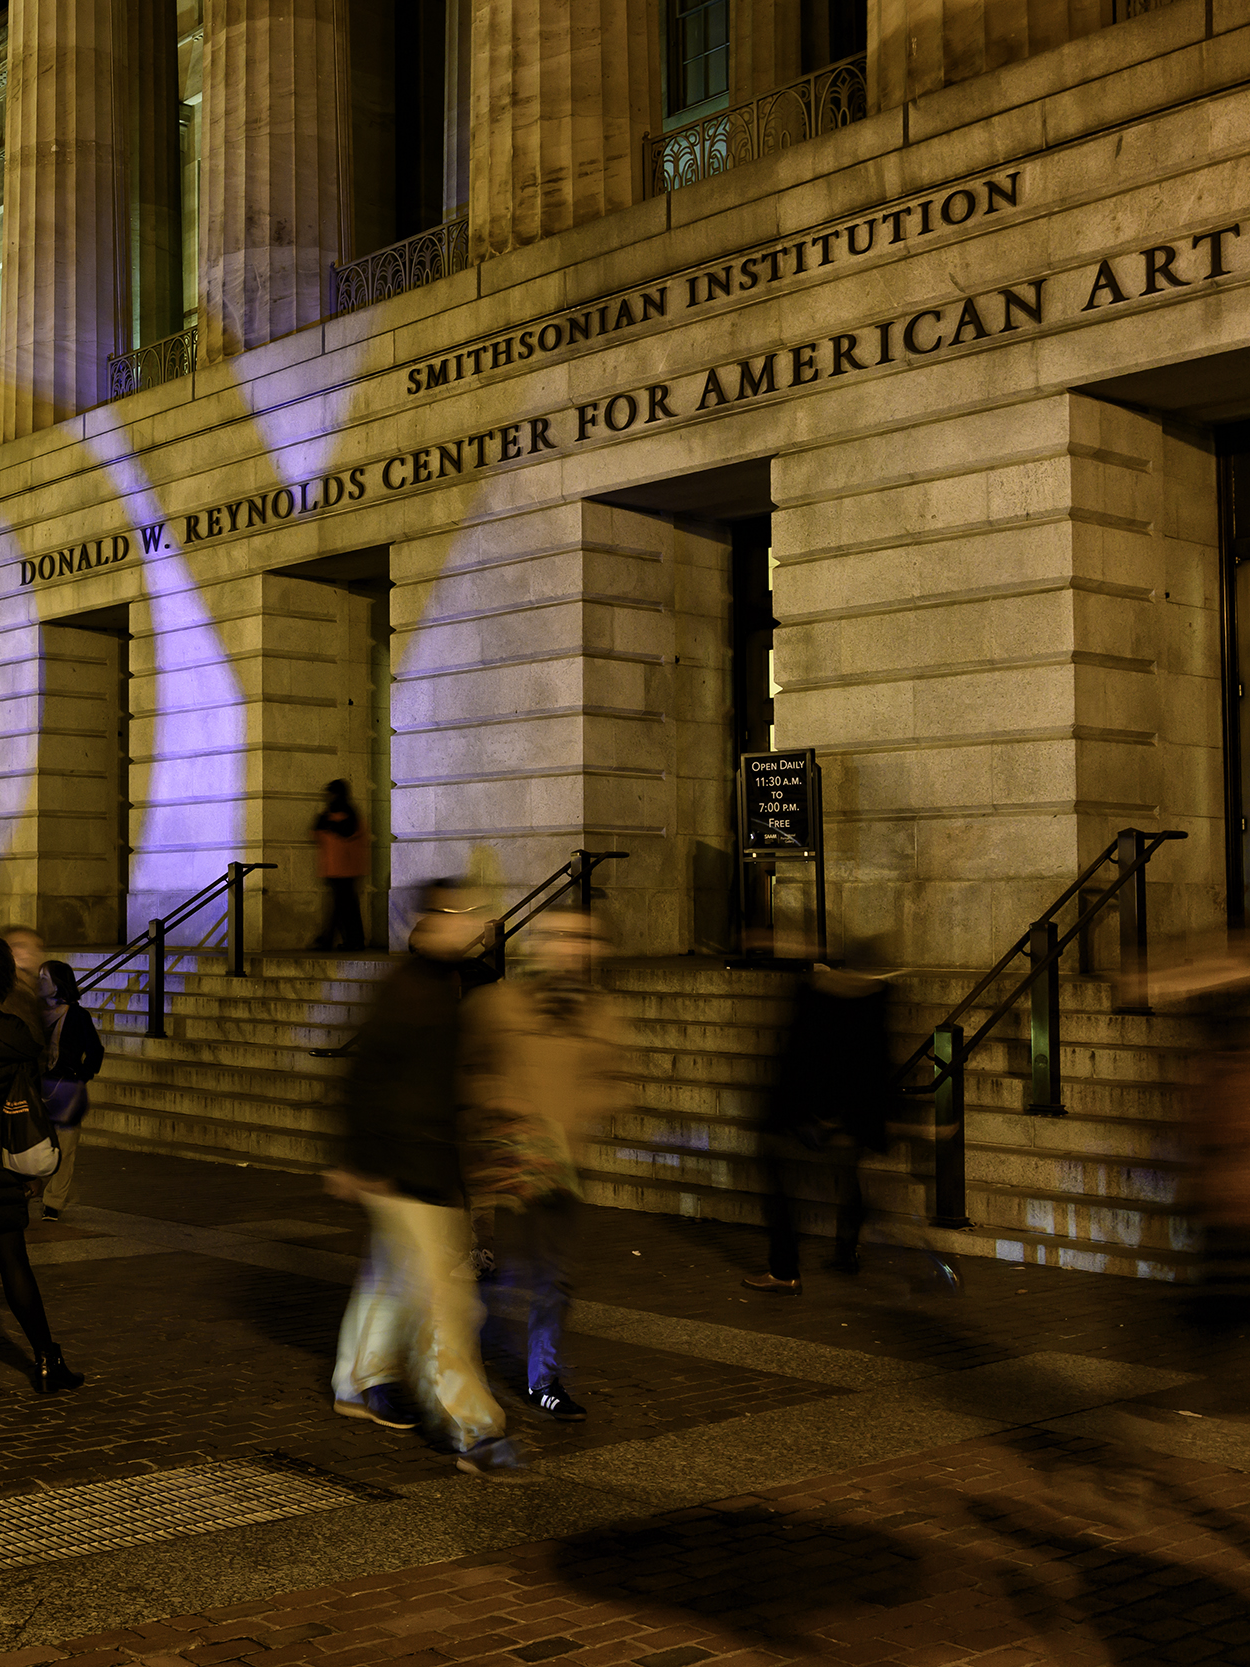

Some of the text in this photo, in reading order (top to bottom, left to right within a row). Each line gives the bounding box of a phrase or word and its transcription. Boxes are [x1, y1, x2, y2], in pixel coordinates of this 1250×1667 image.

[407, 172, 1022, 395] SMITHSONIAN INSTITUTION
[19, 222, 1242, 587] DONALD W. REYNOLDS CENTER FOR AMERICAN ART
[755, 775, 802, 787] 11:30 A.M.
[771, 790, 783, 800] TO
[758, 801, 800, 813] 7:00 P.M.
